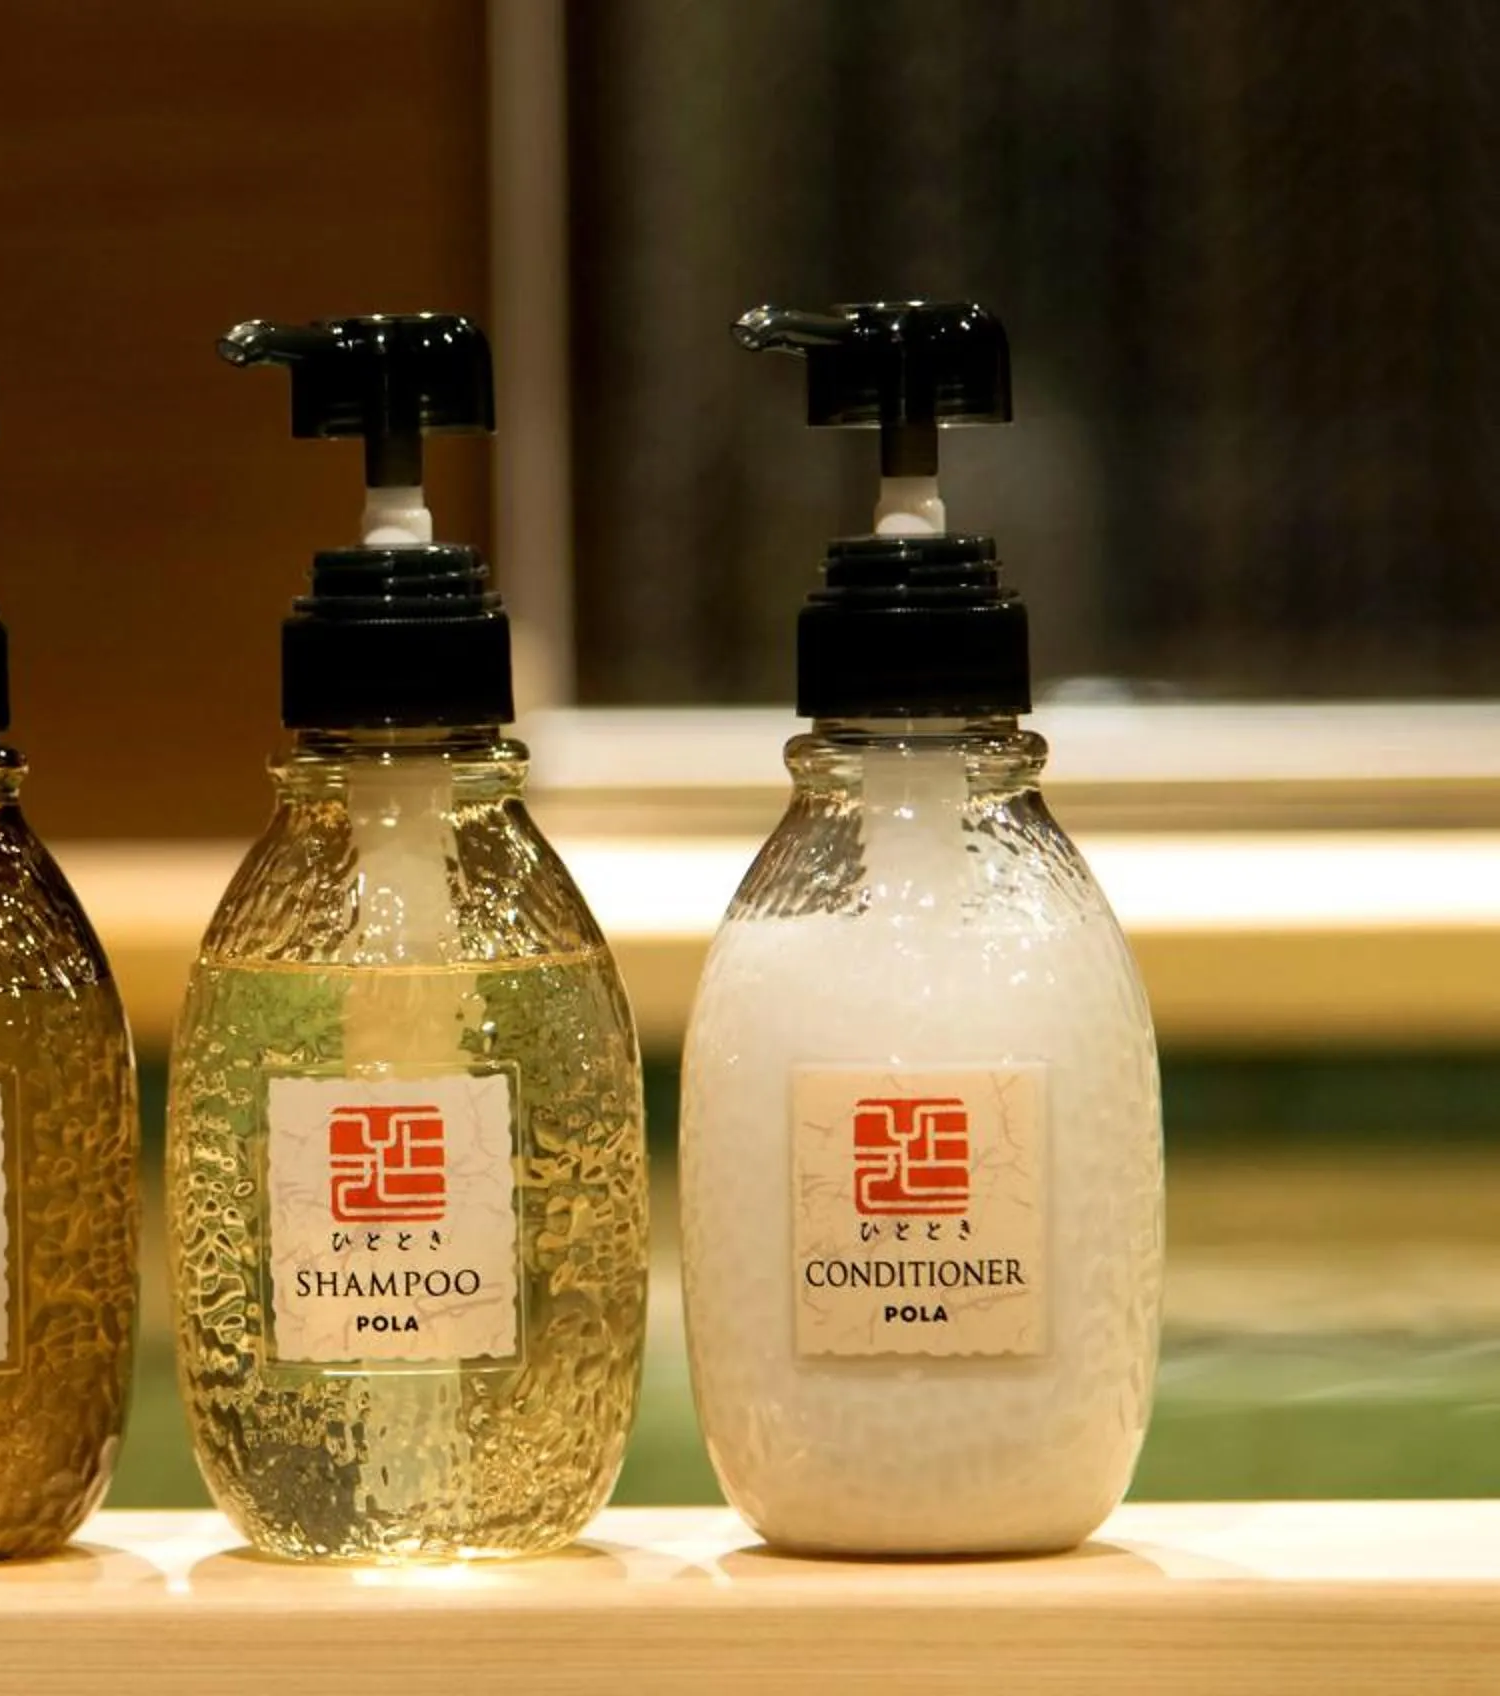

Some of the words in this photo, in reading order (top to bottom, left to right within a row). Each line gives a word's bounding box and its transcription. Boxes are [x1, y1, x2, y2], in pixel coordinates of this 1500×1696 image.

[332, 1230, 441, 1251] ひととき
[860, 1219, 971, 1242] ひととき
[295, 1269, 481, 1297] SHAMPOO
[805, 1258, 1026, 1288] CONDITIONER
[356, 1316, 419, 1332] POLA
[884, 1305, 948, 1323] POLA
